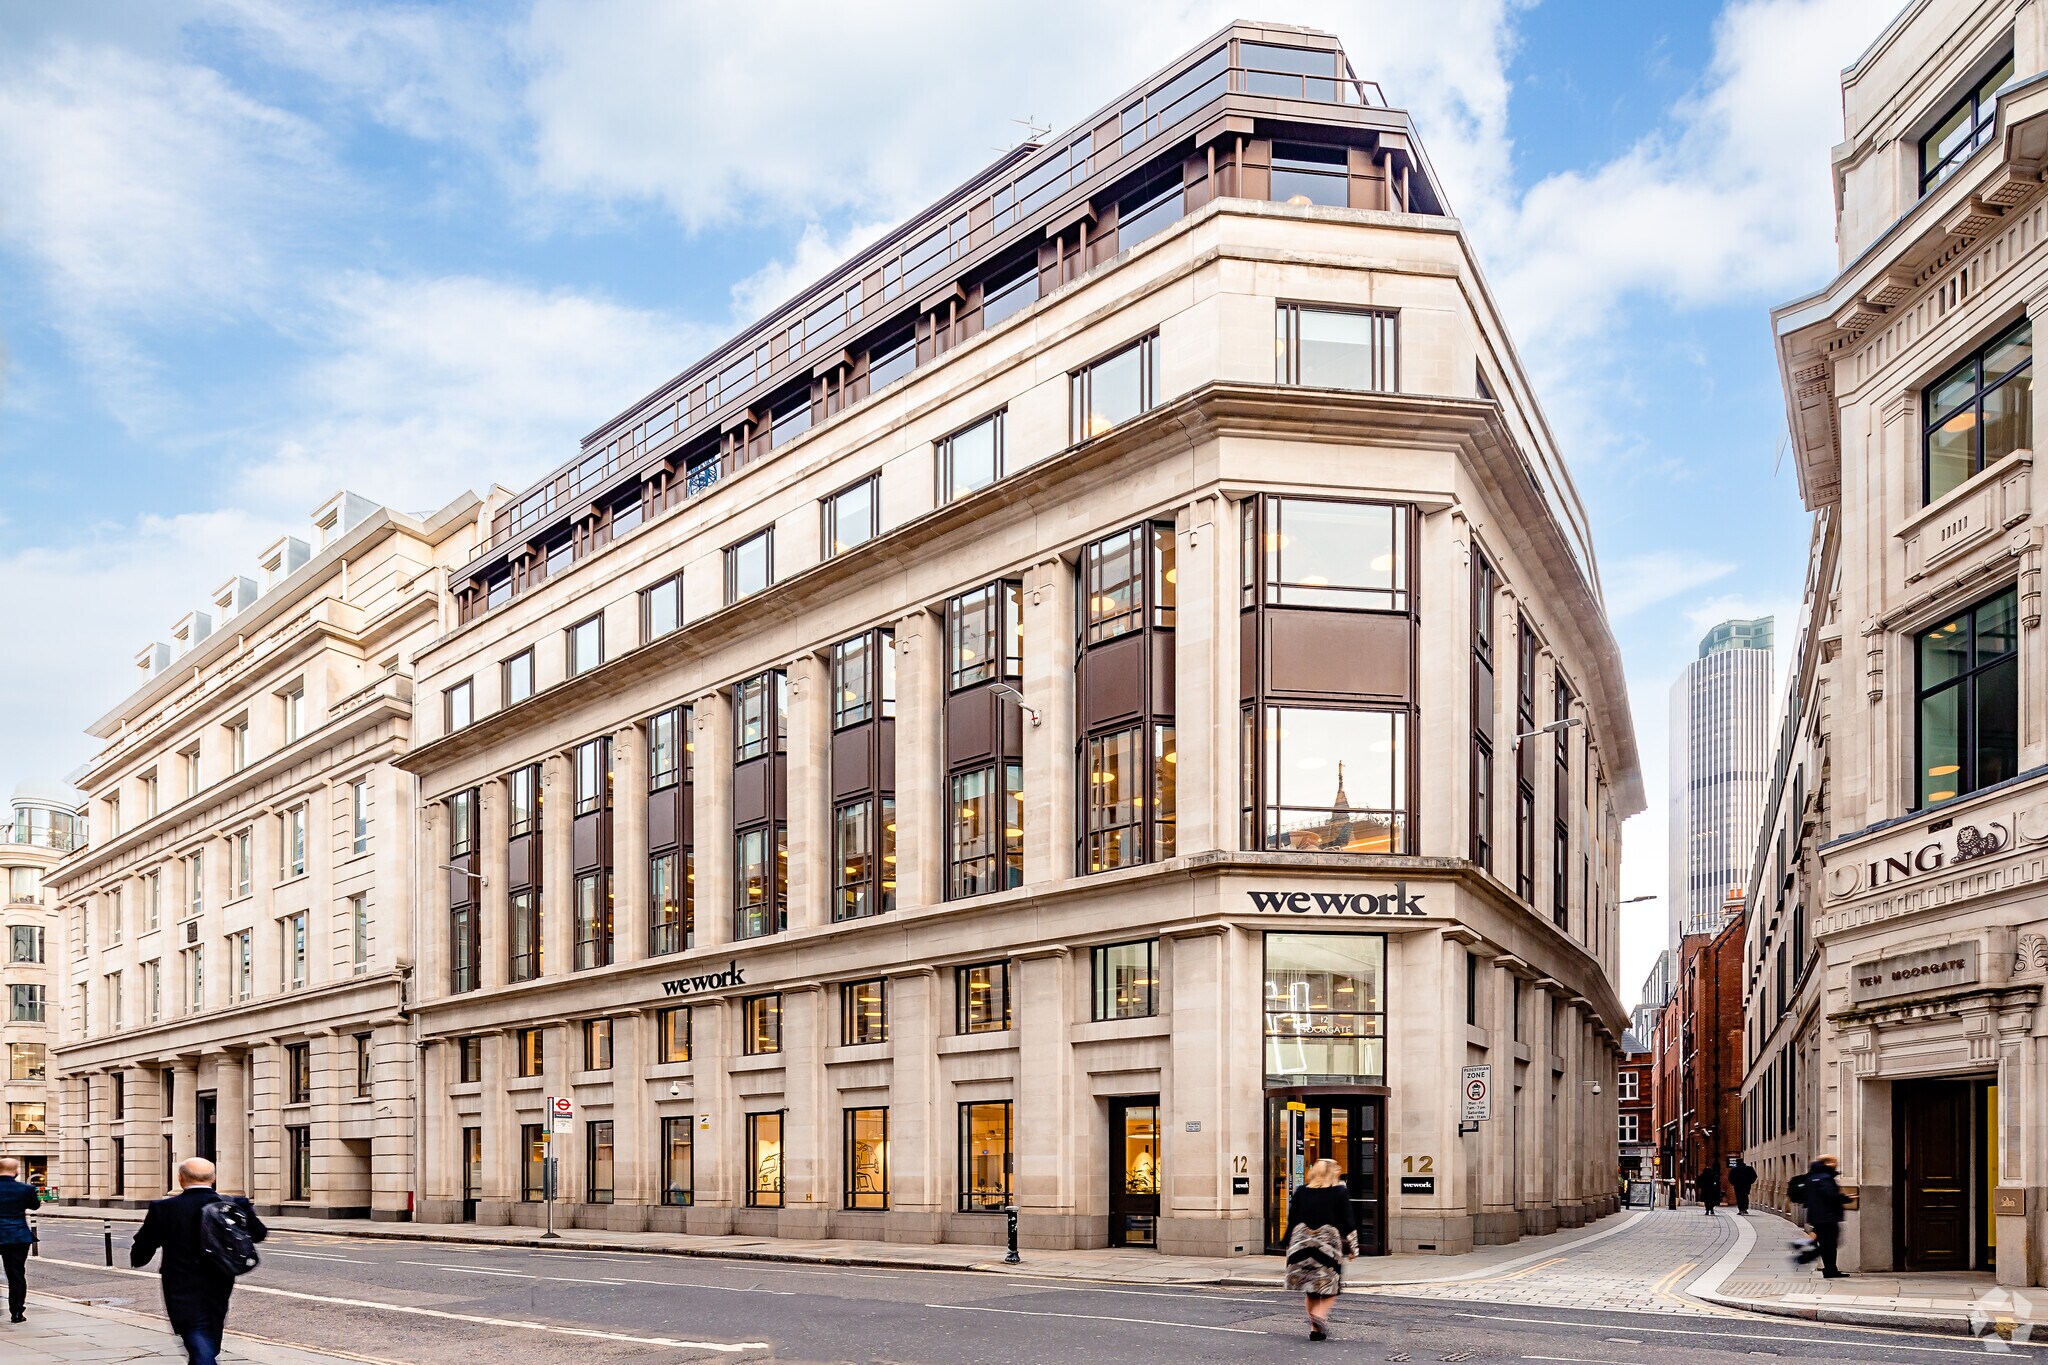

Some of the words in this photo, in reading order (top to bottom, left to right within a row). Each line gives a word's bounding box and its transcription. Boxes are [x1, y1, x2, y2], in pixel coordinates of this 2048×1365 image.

[1868, 841, 1945, 888] ING
[1247, 881, 1427, 916] wework
[662, 960, 746, 995] wework
[1858, 975, 1882, 987] TEN
[1892, 959, 1965, 981] MOORGATE
[1320, 1015, 1328, 1023] 12
[1234, 1156, 1247, 1173] 12
[1403, 1155, 1433, 1173] 12
